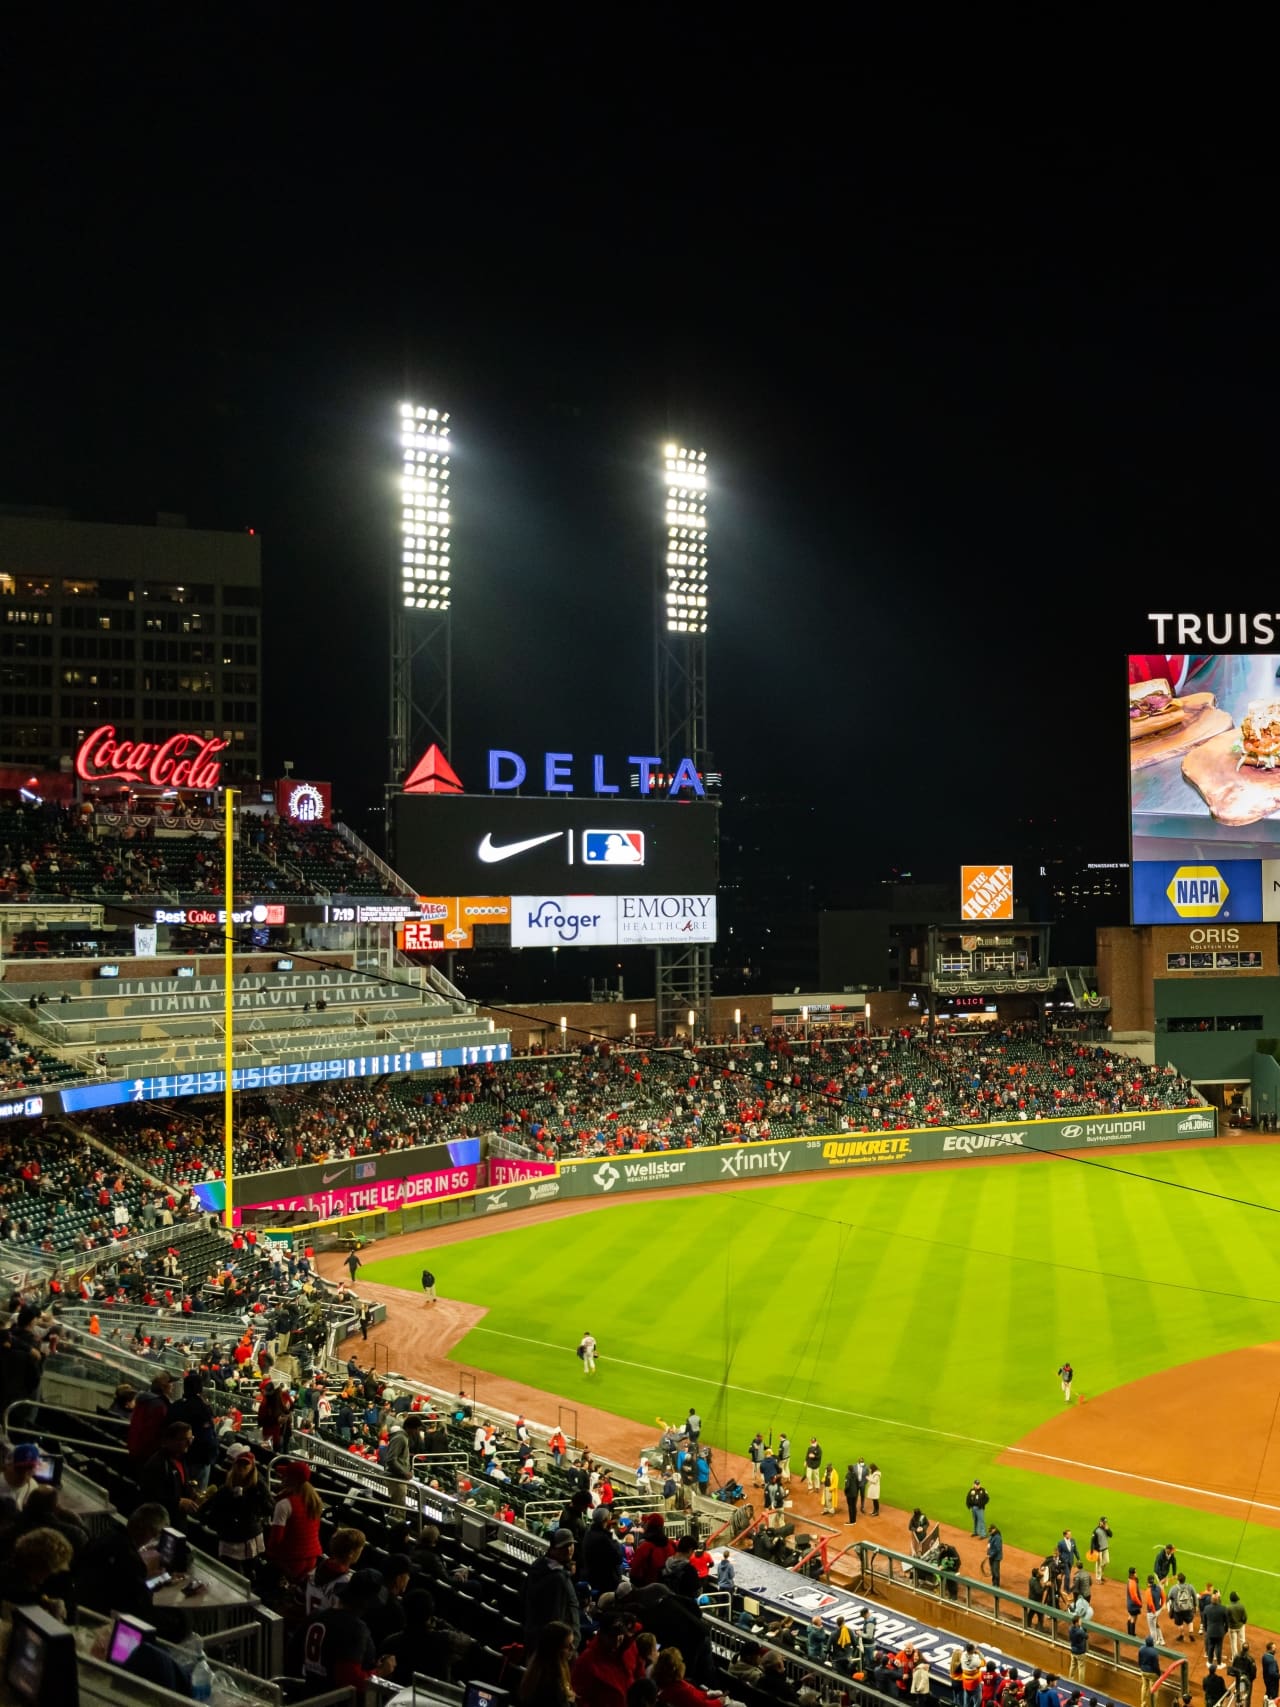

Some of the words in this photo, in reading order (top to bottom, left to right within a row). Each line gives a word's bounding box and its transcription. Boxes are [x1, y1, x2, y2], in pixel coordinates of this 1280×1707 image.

[75, 724, 229, 790] Coca-Cola
[489, 749, 705, 796] DELTA
[962, 866, 1013, 919] HOME
[968, 872, 989, 893] THE
[1177, 880, 1219, 904] NAPA
[623, 898, 711, 918] EMORY
[982, 886, 1013, 918] DEPOT
[156, 910, 186, 923] Best
[188, 910, 217, 923] Coke
[219, 911, 252, 923] Eer?
[333, 908, 355, 922] 7:19
[528, 901, 601, 941] Kroger
[405, 925, 431, 940] 22
[623, 920, 708, 931] HEALTHCARE
[1189, 928, 1240, 943] ORIS
[406, 941, 444, 949] MILLION
[956, 998, 984, 1006] SLICE
[157, 1077, 170, 1097] 1
[179, 1074, 194, 1095] 2
[204, 1072, 217, 1092] 3
[250, 1068, 261, 1086] 5
[268, 1065, 282, 1084] 6
[290, 1063, 302, 1082] 7
[309, 1061, 322, 1080] 8
[329, 1060, 342, 1078] 9
[1087, 1121, 1145, 1135] HYUNDAI
[806, 1140, 821, 1149] 385
[823, 1138, 910, 1158] QUIKRETE
[943, 1132, 1025, 1153] EQUIFAX
[561, 1166, 576, 1174] 375
[624, 1161, 686, 1177] Wellstar
[720, 1147, 791, 1176] xfinity
[350, 1189, 378, 1214] THE
[381, 1180, 432, 1203] LEADER
[436, 1176, 448, 1194] IN
[451, 1172, 469, 1189] 5G
